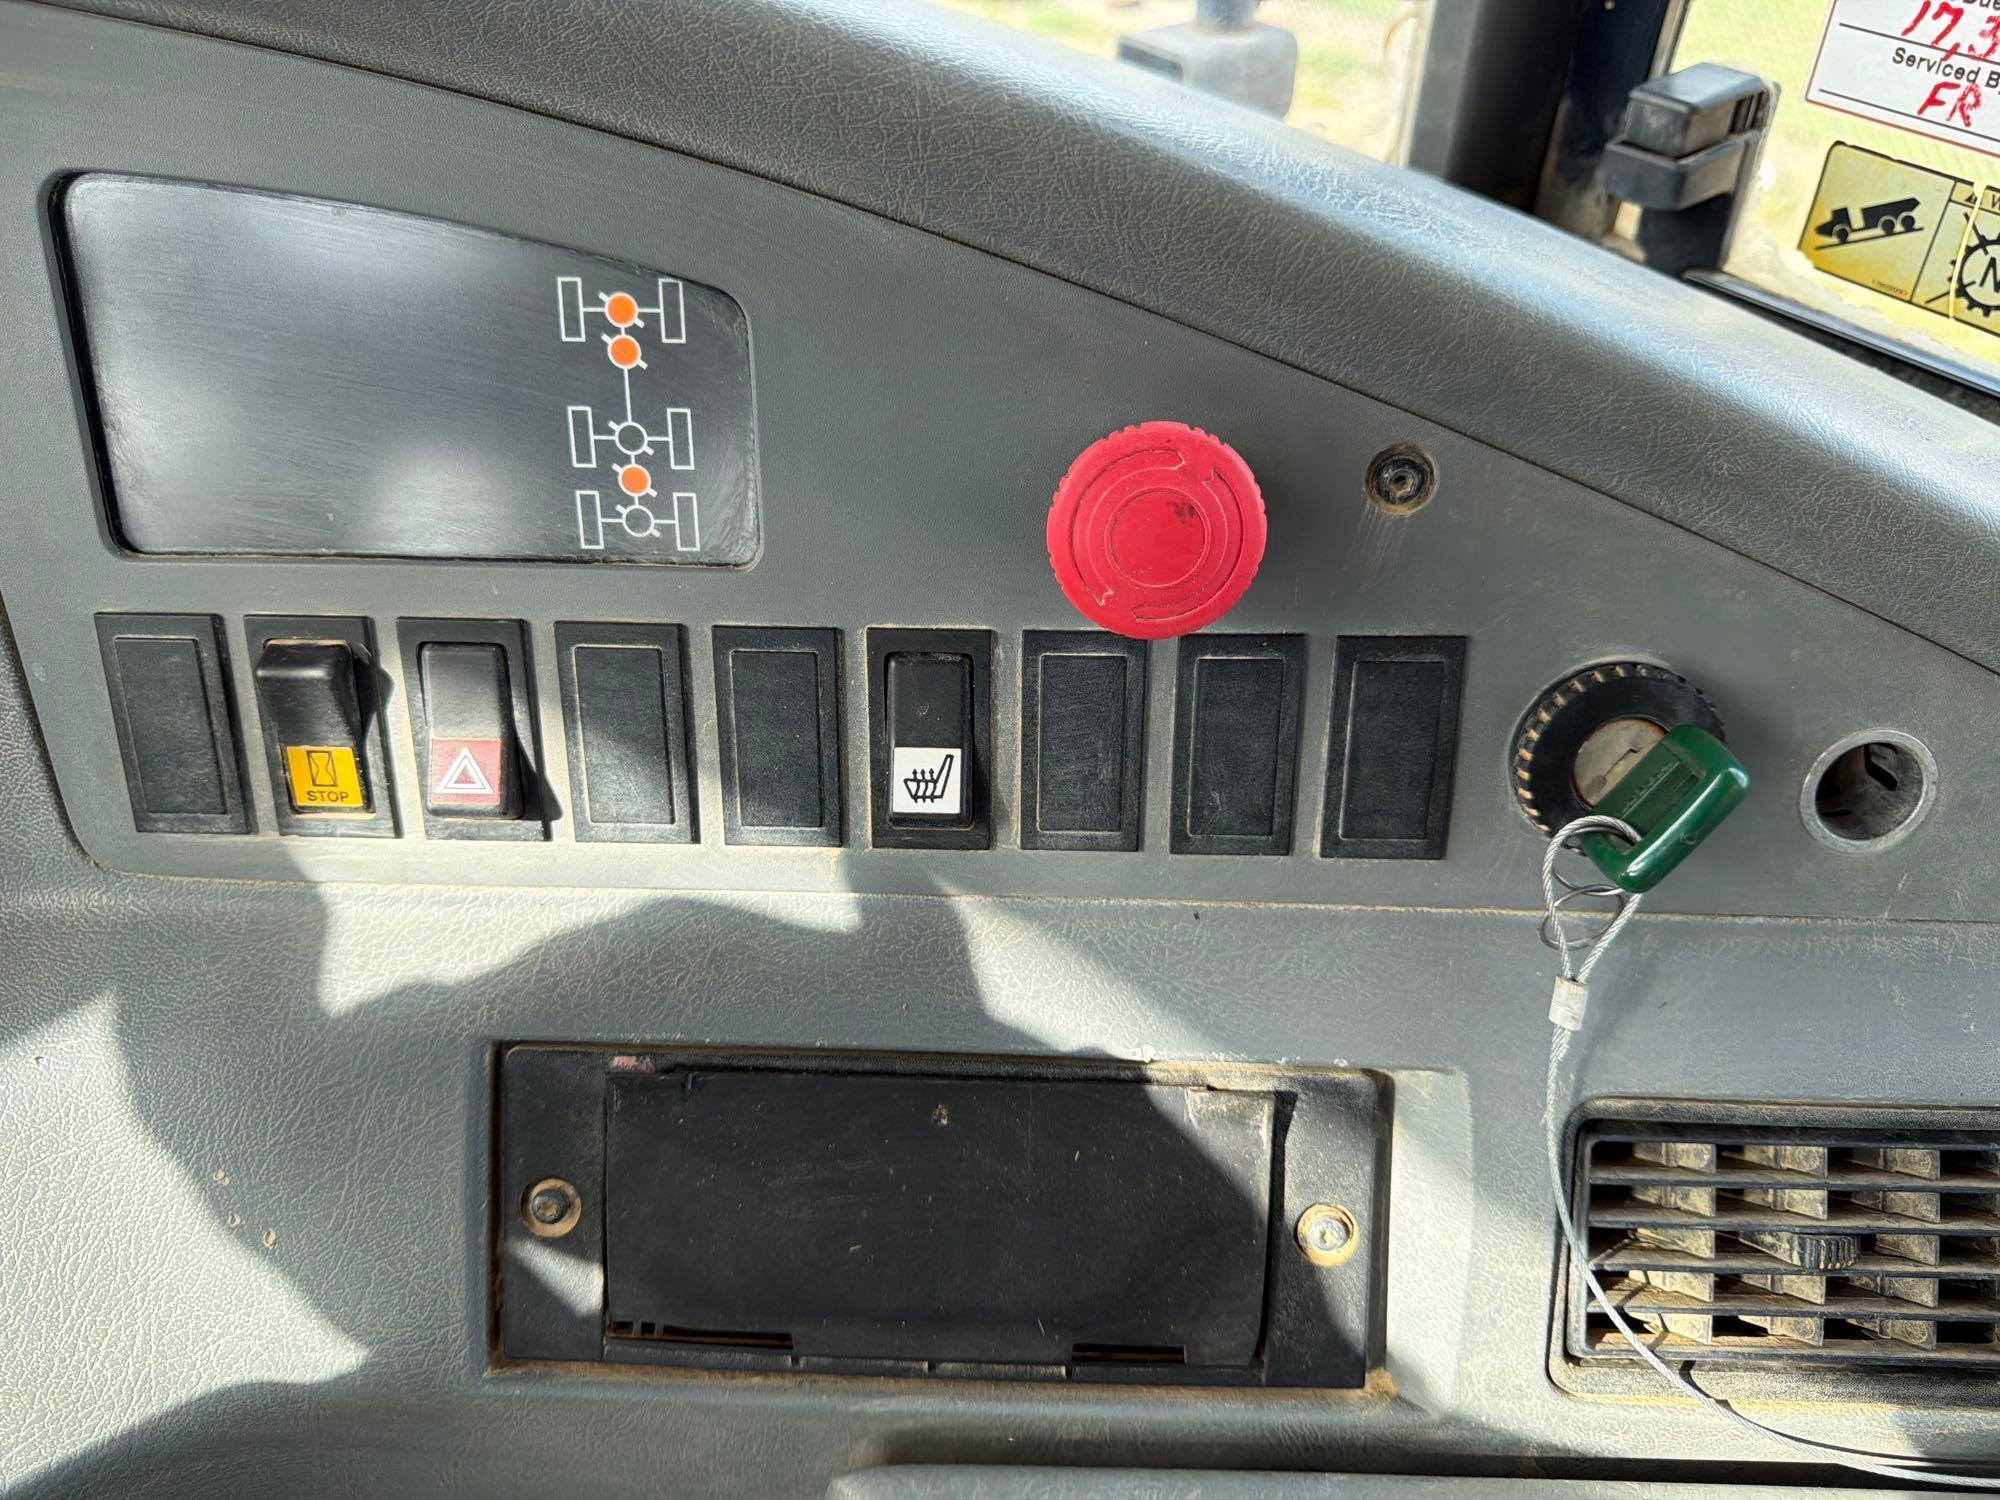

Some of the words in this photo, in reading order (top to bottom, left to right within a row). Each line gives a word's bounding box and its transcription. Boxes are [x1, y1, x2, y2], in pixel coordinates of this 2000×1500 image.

[1892, 47, 1981, 84] Serviced
[1985, 70, 2000, 96] B
[1917, 81, 1982, 128] FR
[306, 790, 349, 803] STOP
